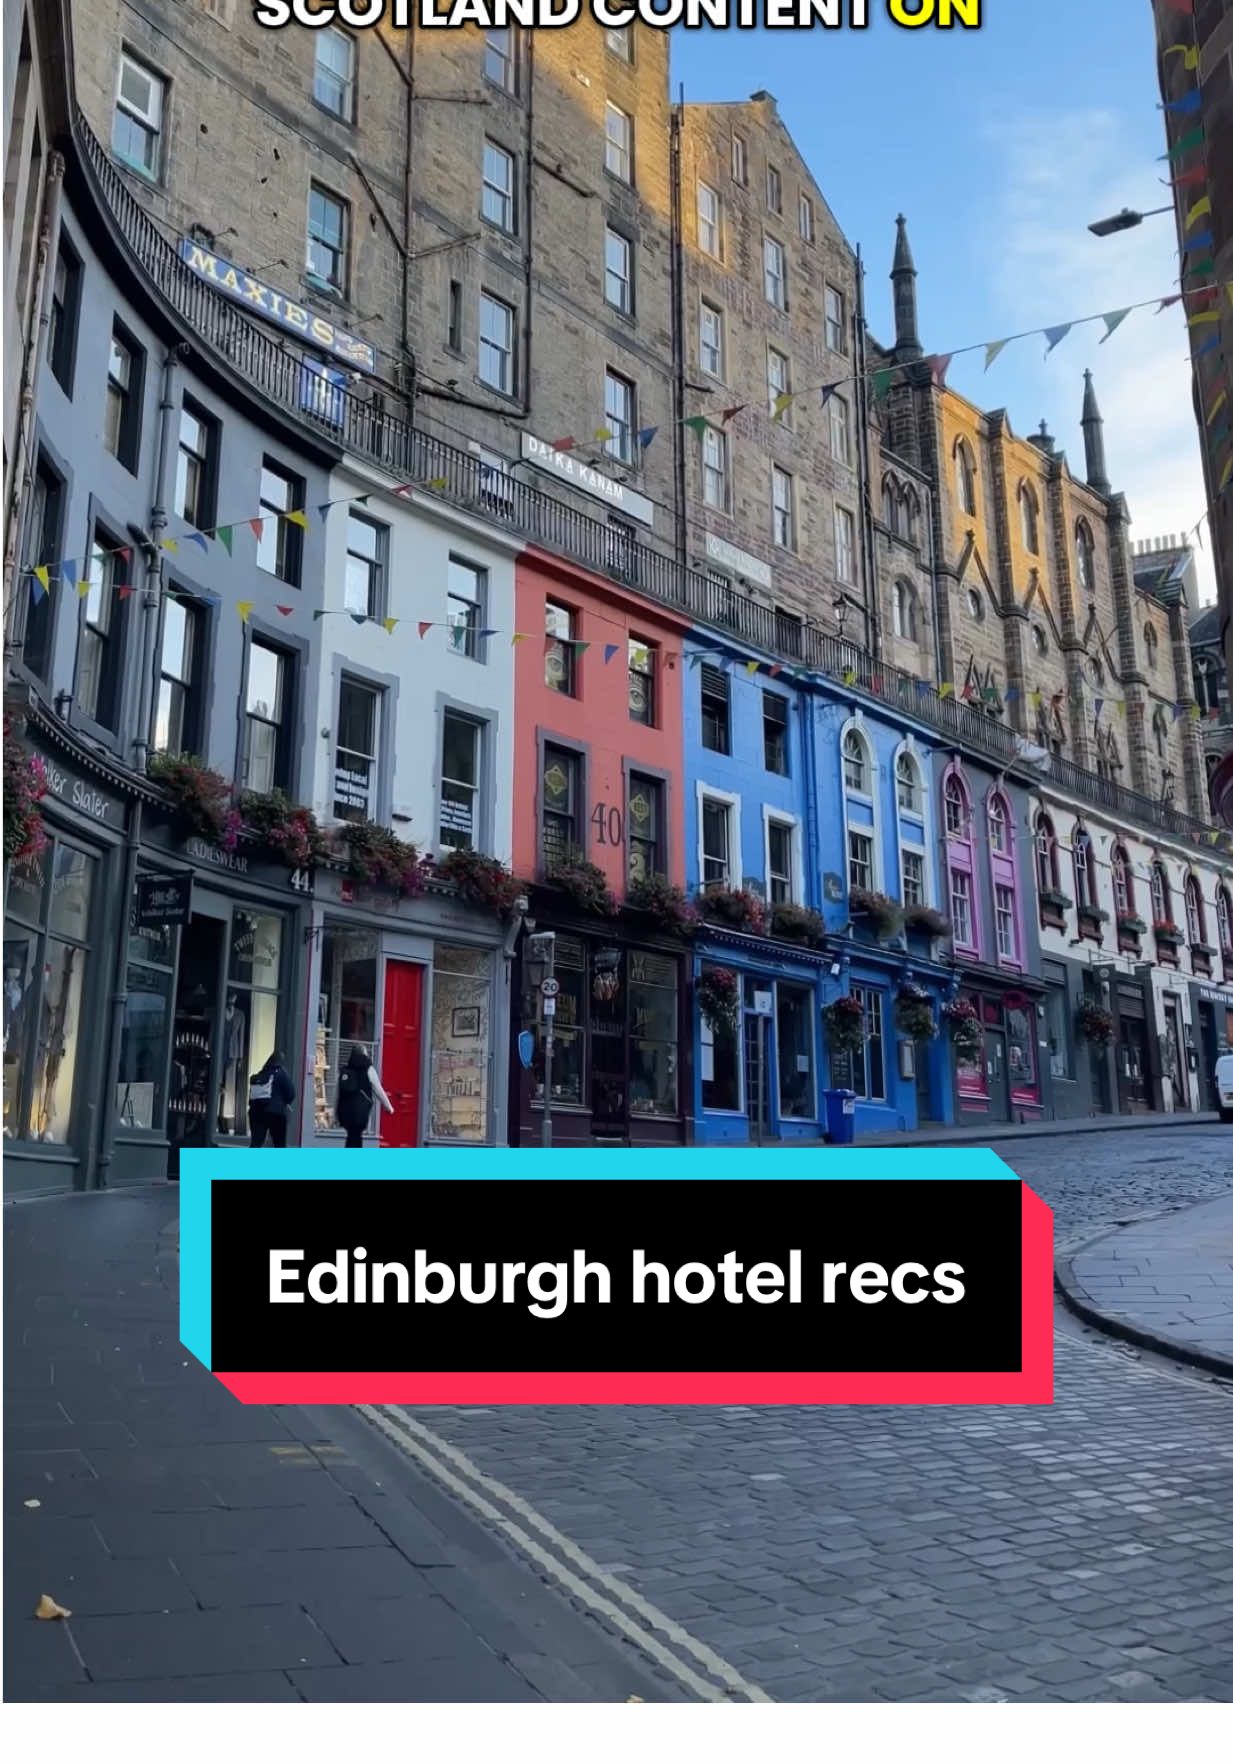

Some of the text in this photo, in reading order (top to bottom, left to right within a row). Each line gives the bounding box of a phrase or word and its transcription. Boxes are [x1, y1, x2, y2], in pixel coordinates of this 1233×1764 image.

[188, 246, 335, 345] MAXIES
[72, 780, 109, 818] Slater
[591, 802, 622, 847] 40
[543, 982, 557, 991] 20
